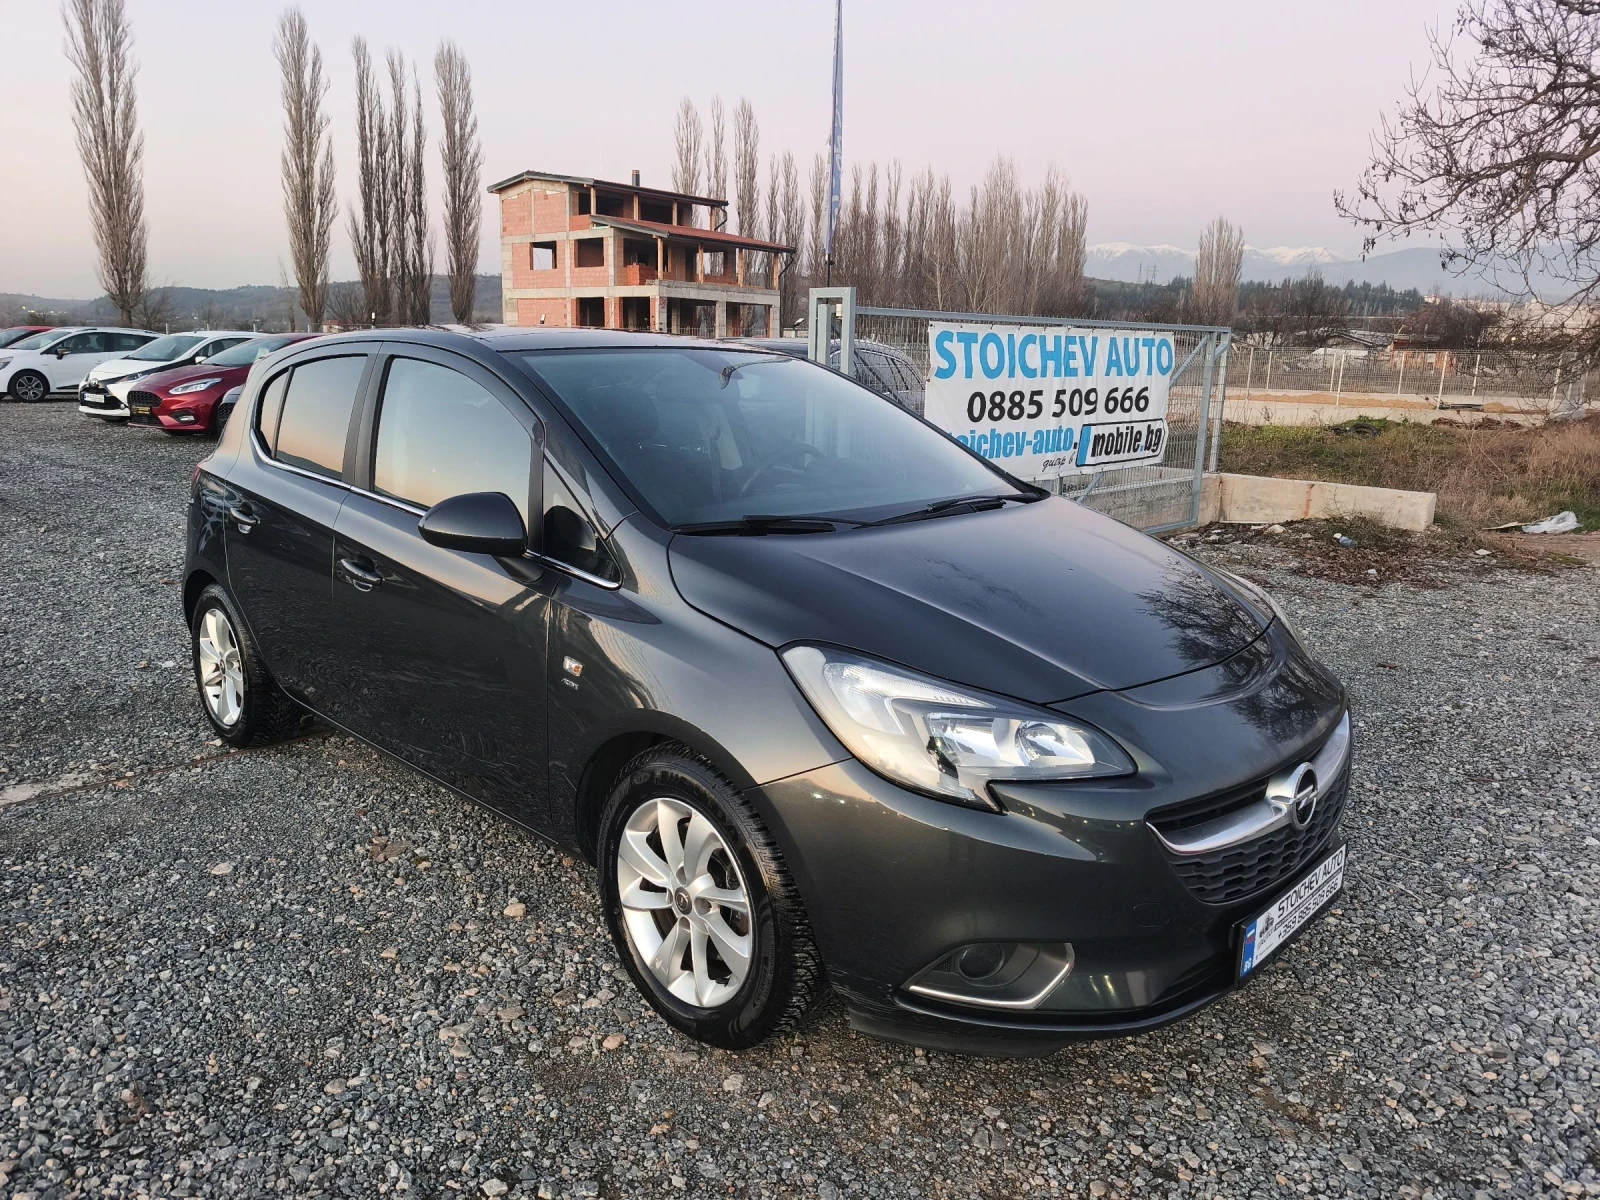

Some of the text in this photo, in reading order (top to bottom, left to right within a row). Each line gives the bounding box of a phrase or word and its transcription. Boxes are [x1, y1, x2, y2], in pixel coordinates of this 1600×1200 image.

[934, 330, 1173, 379] STOICHEV AUTO
[967, 386, 1149, 423] 0885 509 666
[1090, 424, 1162, 458] mobile.bg
[1277, 850, 1343, 919] STOICHEV AUTO
